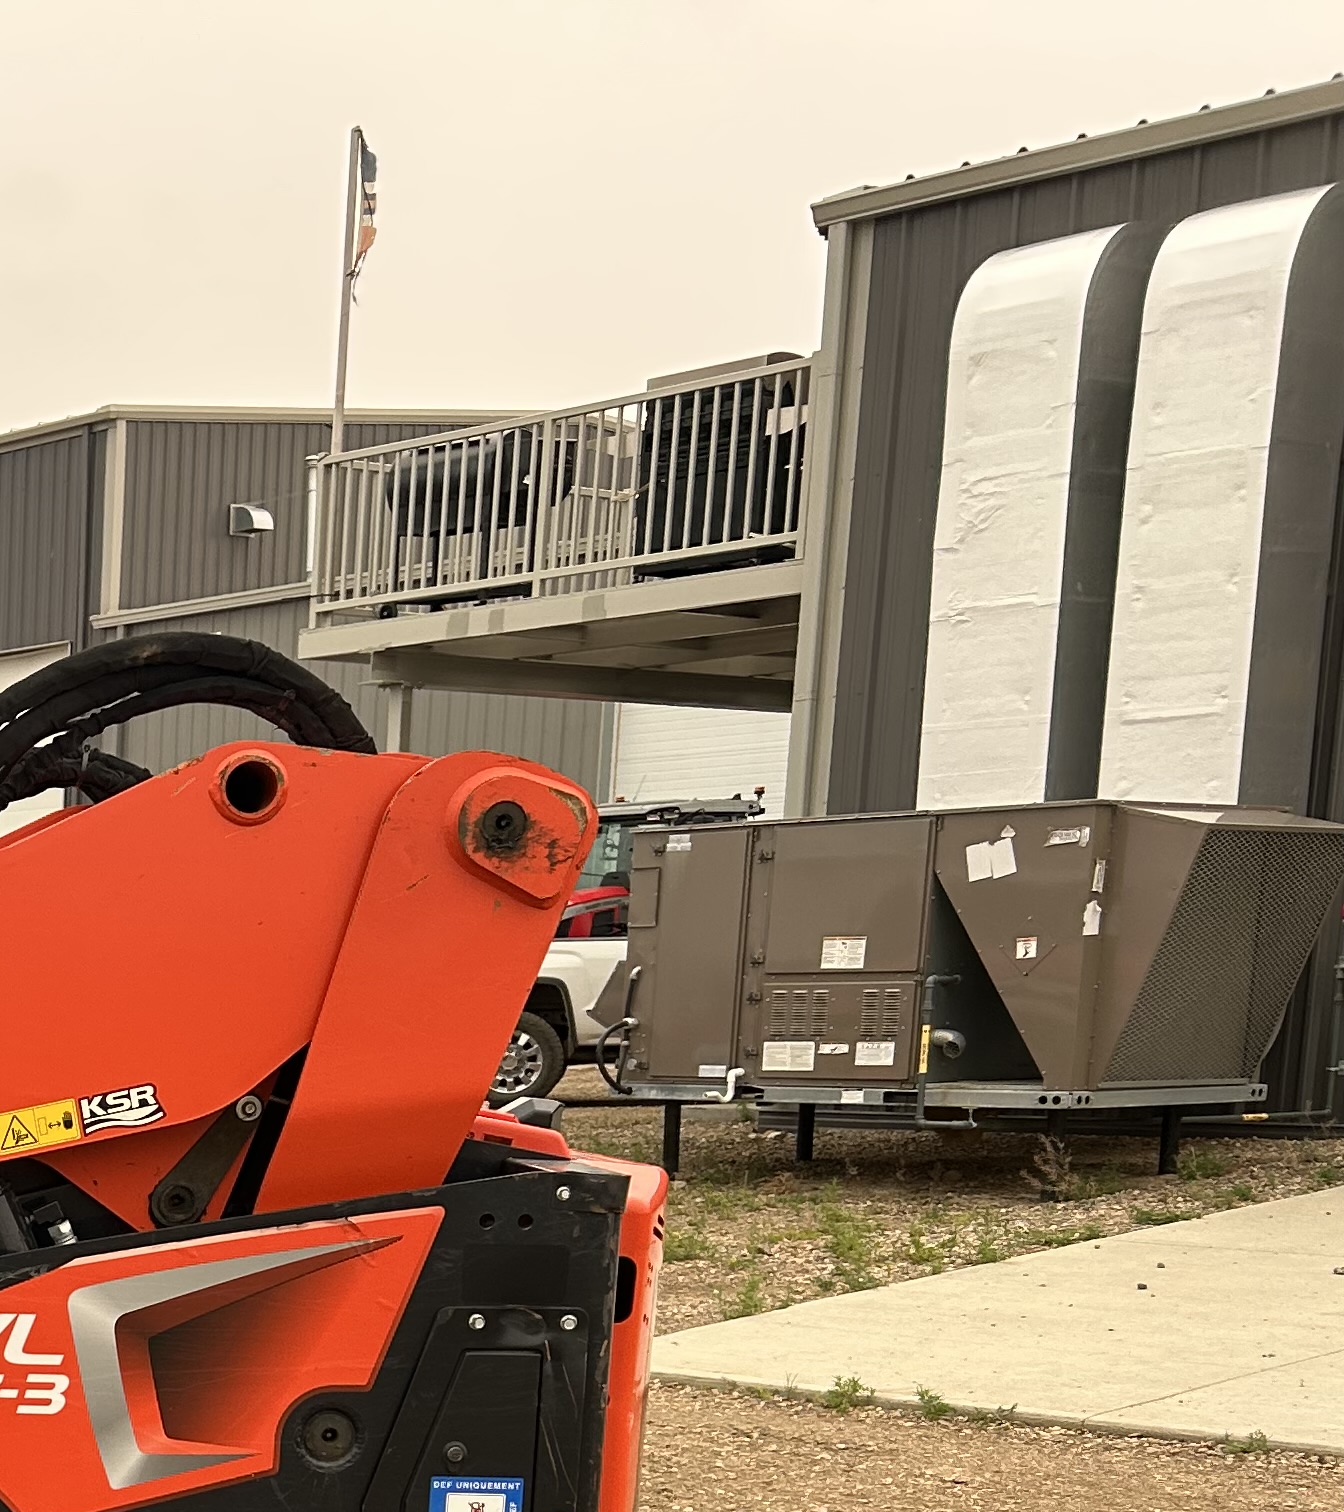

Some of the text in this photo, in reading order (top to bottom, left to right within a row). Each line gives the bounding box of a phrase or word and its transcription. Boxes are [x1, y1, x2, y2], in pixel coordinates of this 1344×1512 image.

[80, 1085, 156, 1119] KSR
[433, 1481, 521, 1490] DEF UNIQUEMENT
